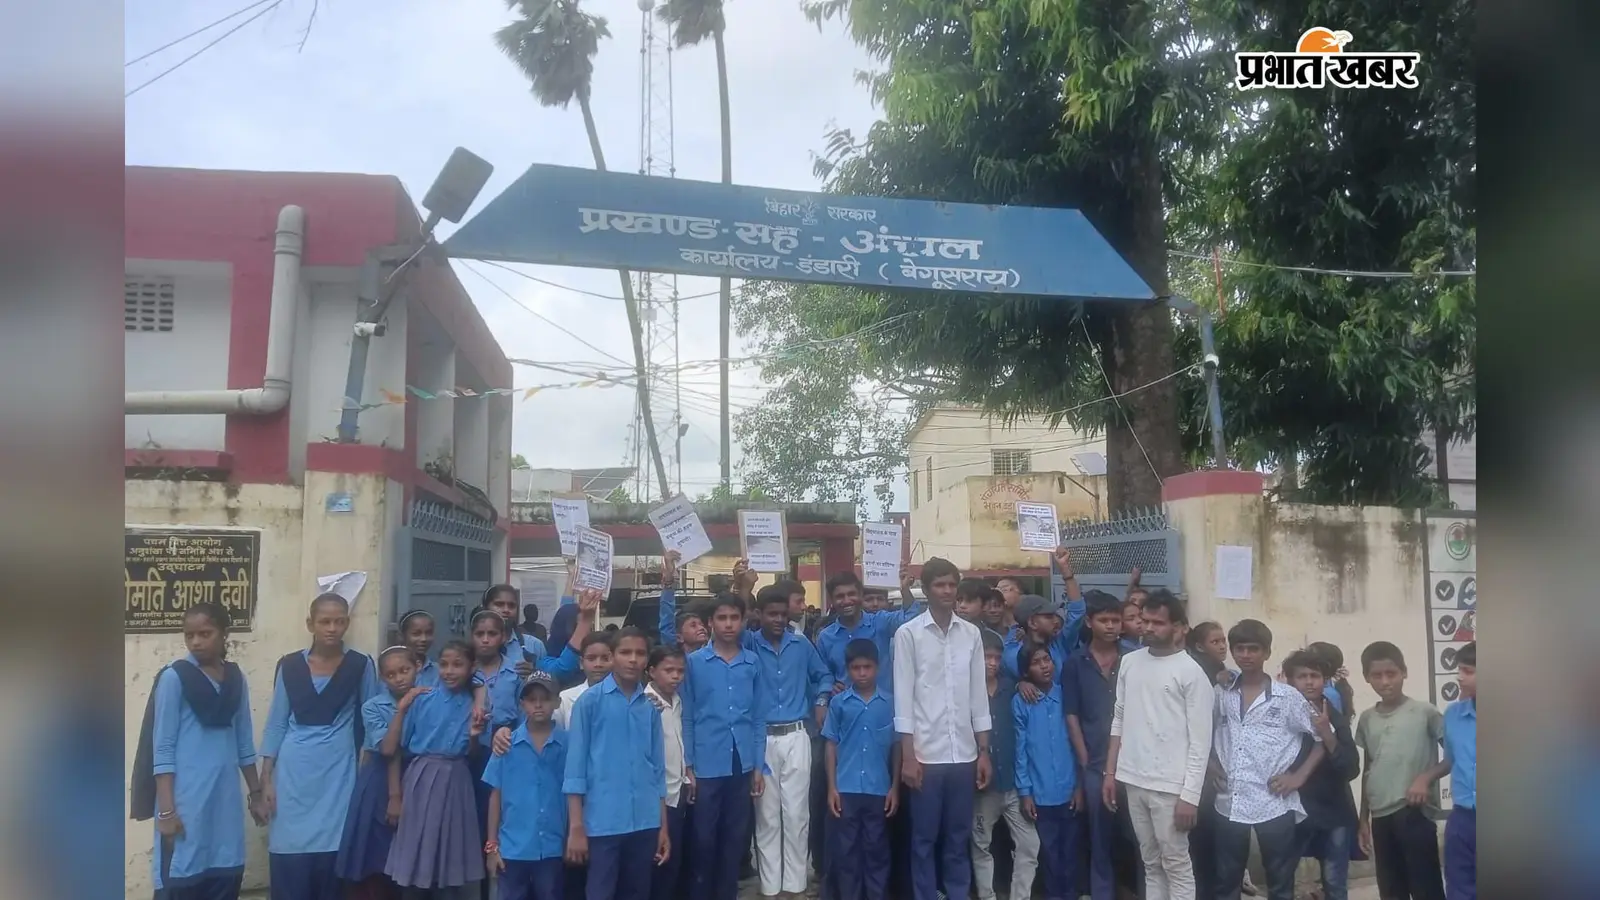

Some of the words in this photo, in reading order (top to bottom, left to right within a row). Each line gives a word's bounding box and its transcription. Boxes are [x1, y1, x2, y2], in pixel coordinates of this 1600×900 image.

[764, 196, 801, 217] बिहार
[827, 206, 877, 224] सरकार
[190, 537, 221, 547] आयोग
[125, 567, 166, 611] ीमति
[172, 580, 215, 610] आशा
[220, 567, 249, 611] देवी
